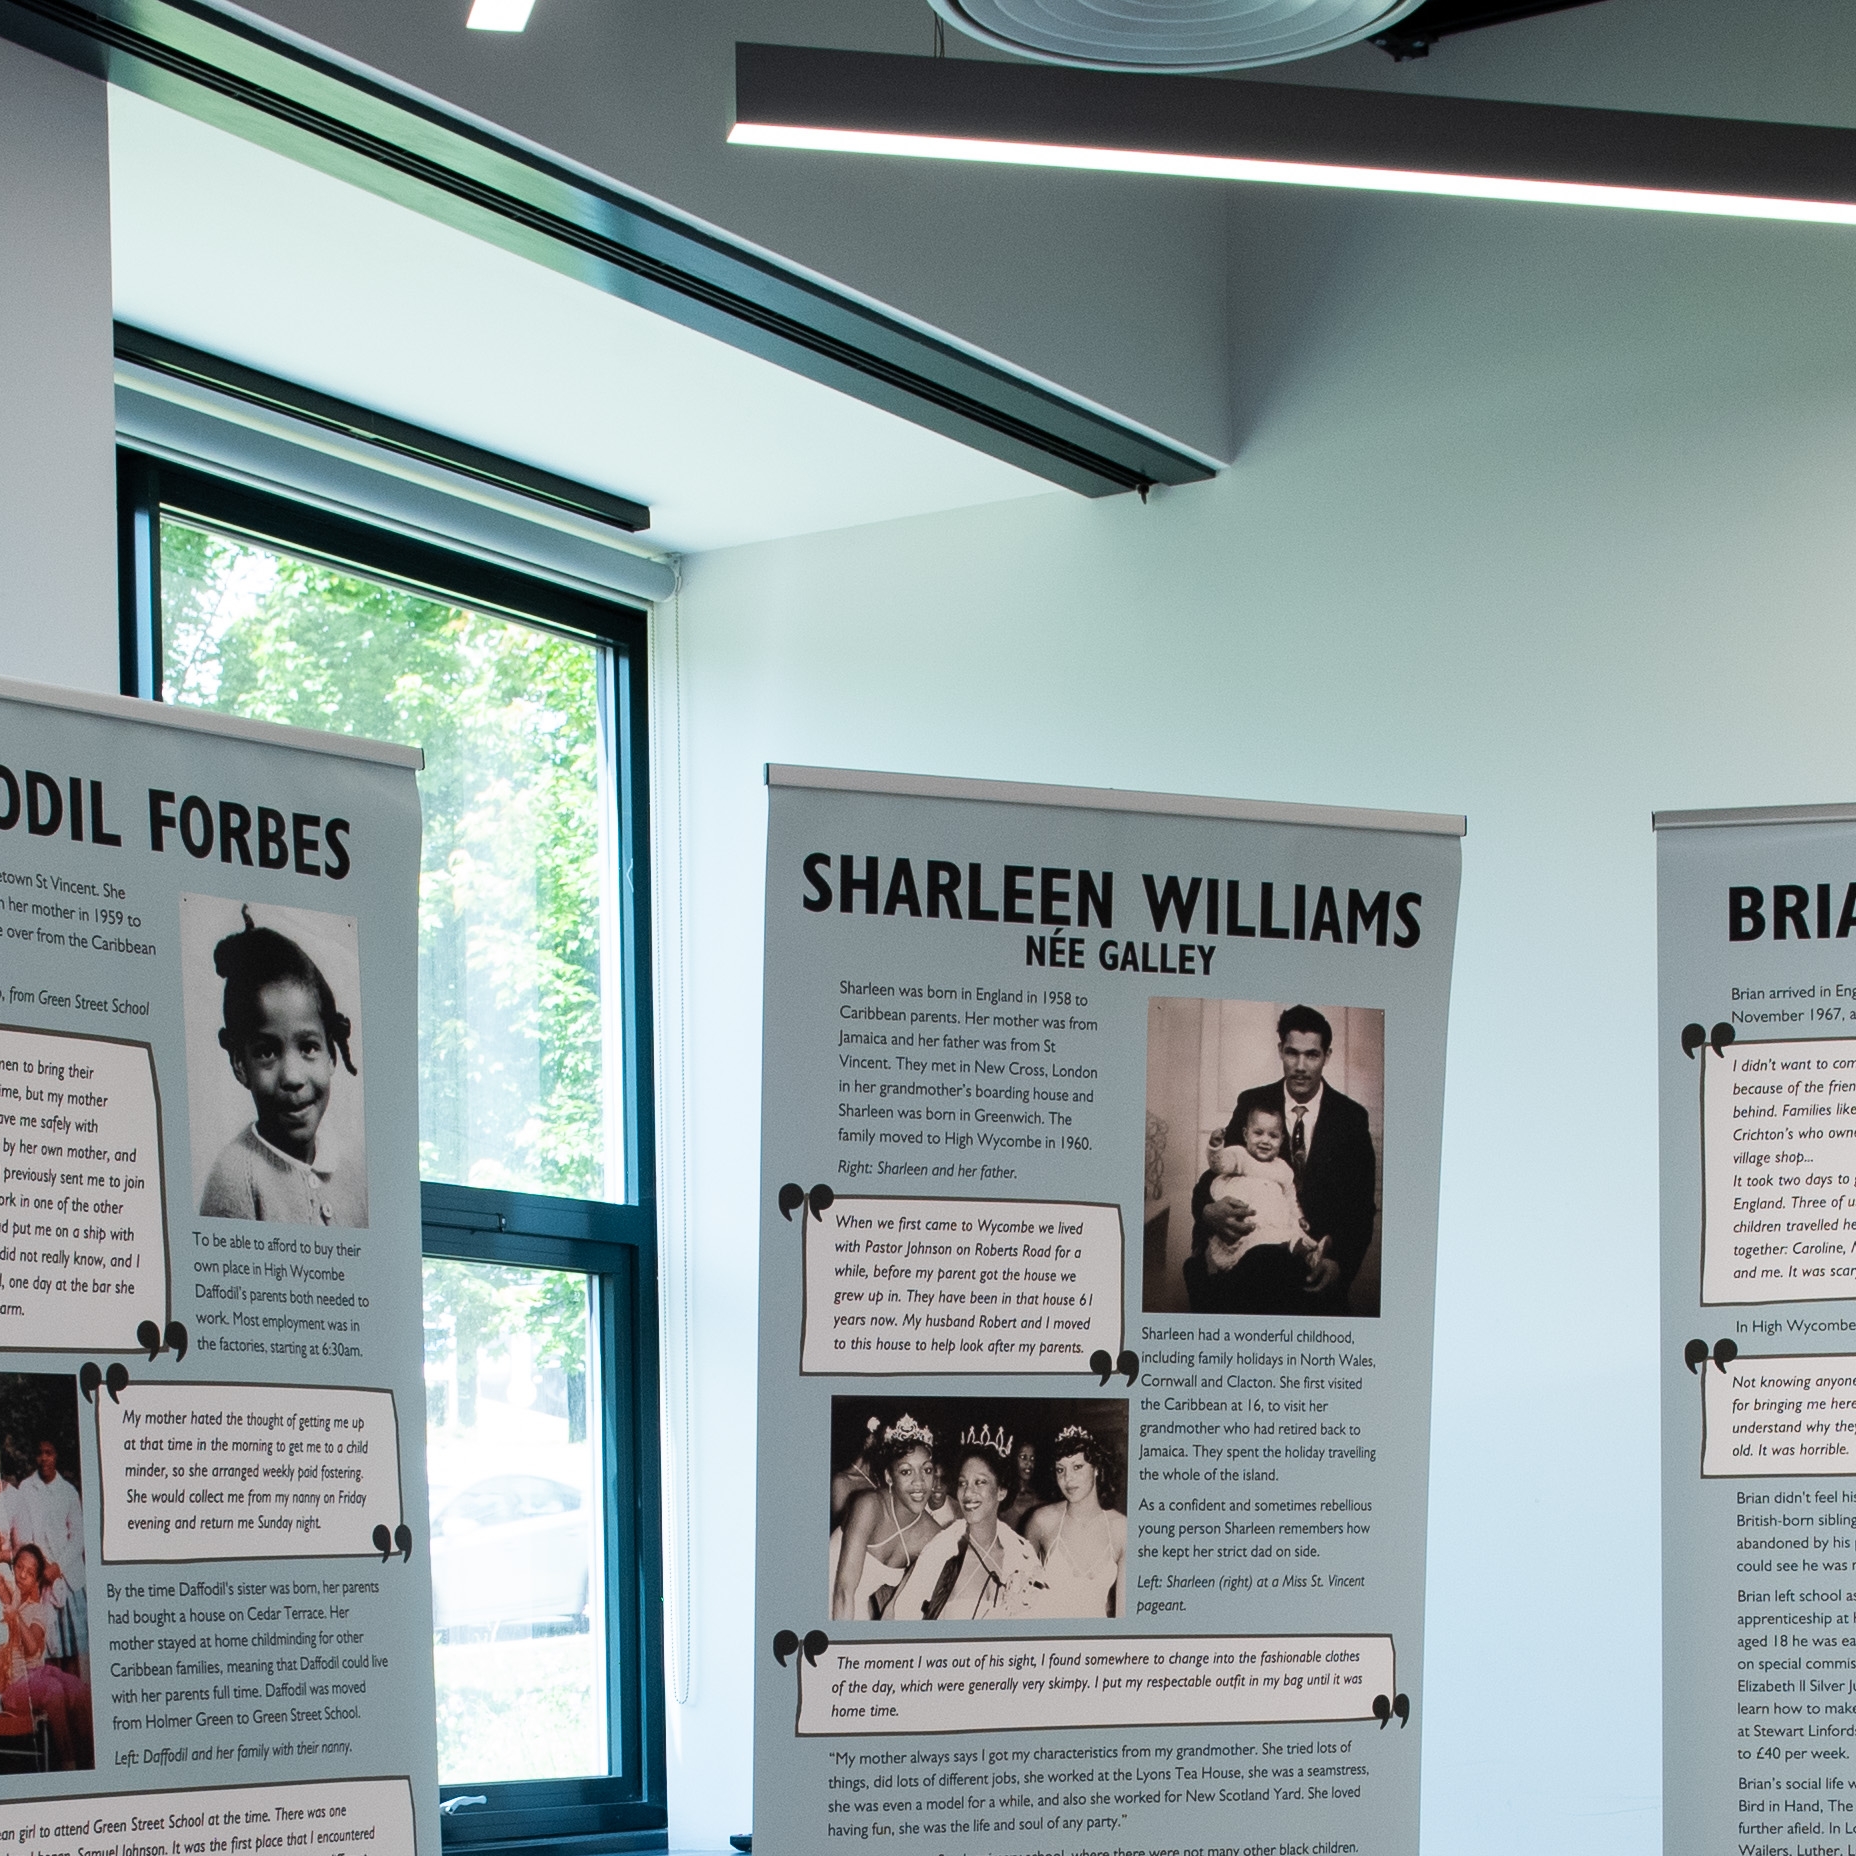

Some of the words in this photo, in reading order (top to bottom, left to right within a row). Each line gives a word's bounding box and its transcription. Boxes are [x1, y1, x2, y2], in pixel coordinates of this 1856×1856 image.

[148, 788, 351, 880] FORBES
[35, 873, 48, 890] St
[49, 875, 100, 897] Vincent.
[102, 882, 126, 900] She
[802, 852, 1114, 932] SHARLEEN
[1141, 873, 1422, 949] WILLIAMS
[1026, 927, 1085, 969] NÉE
[1098, 939, 1217, 976] GALLEY
[839, 980, 895, 997] Sharleen
[898, 987, 924, 998] was
[927, 984, 958, 1000] born
[961, 987, 972, 1001] in
[976, 986, 1023, 1006] England
[1026, 990, 1038, 1004] in
[1043, 990, 1072, 1006] 1958
[1075, 995, 1089, 1007] to
[1731, 987, 1765, 1001] Brian
[1768, 985, 1816, 1000] arrived
[1820, 988, 1832, 998] in
[196, 1335, 217, 1351] the
[219, 1336, 268, 1353] factories,
[270, 1342, 308, 1359] starting
[309, 1344, 320, 1356] at
[321, 1341, 363, 1358] 6:30am.
[1137, 1574, 1163, 1591] Left:
[1166, 1574, 1216, 1589] Sharleen
[1218, 1574, 1253, 1592] (right)
[1256, 1577, 1269, 1588] at
[1271, 1578, 1280, 1588] a
[1282, 1574, 1308, 1588] Miss
[1310, 1574, 1324, 1588] St.
[1328, 1574, 1365, 1588] Vincent
[1136, 1600, 1187, 1615] pageant.
[114, 1749, 140, 1769] Left:
[143, 1746, 189, 1766] Daffodil
[191, 1745, 213, 1761] and
[215, 1745, 235, 1760] her
[237, 1743, 270, 1763] family
[271, 1741, 294, 1757] with
[296, 1741, 320, 1756] their
[321, 1742, 352, 1756] nanny.
[1737, 1749, 1752, 1760] to
[1756, 1746, 1781, 1760] £40
[1785, 1750, 1808, 1763] per
[1810, 1746, 1850, 1760] week.
